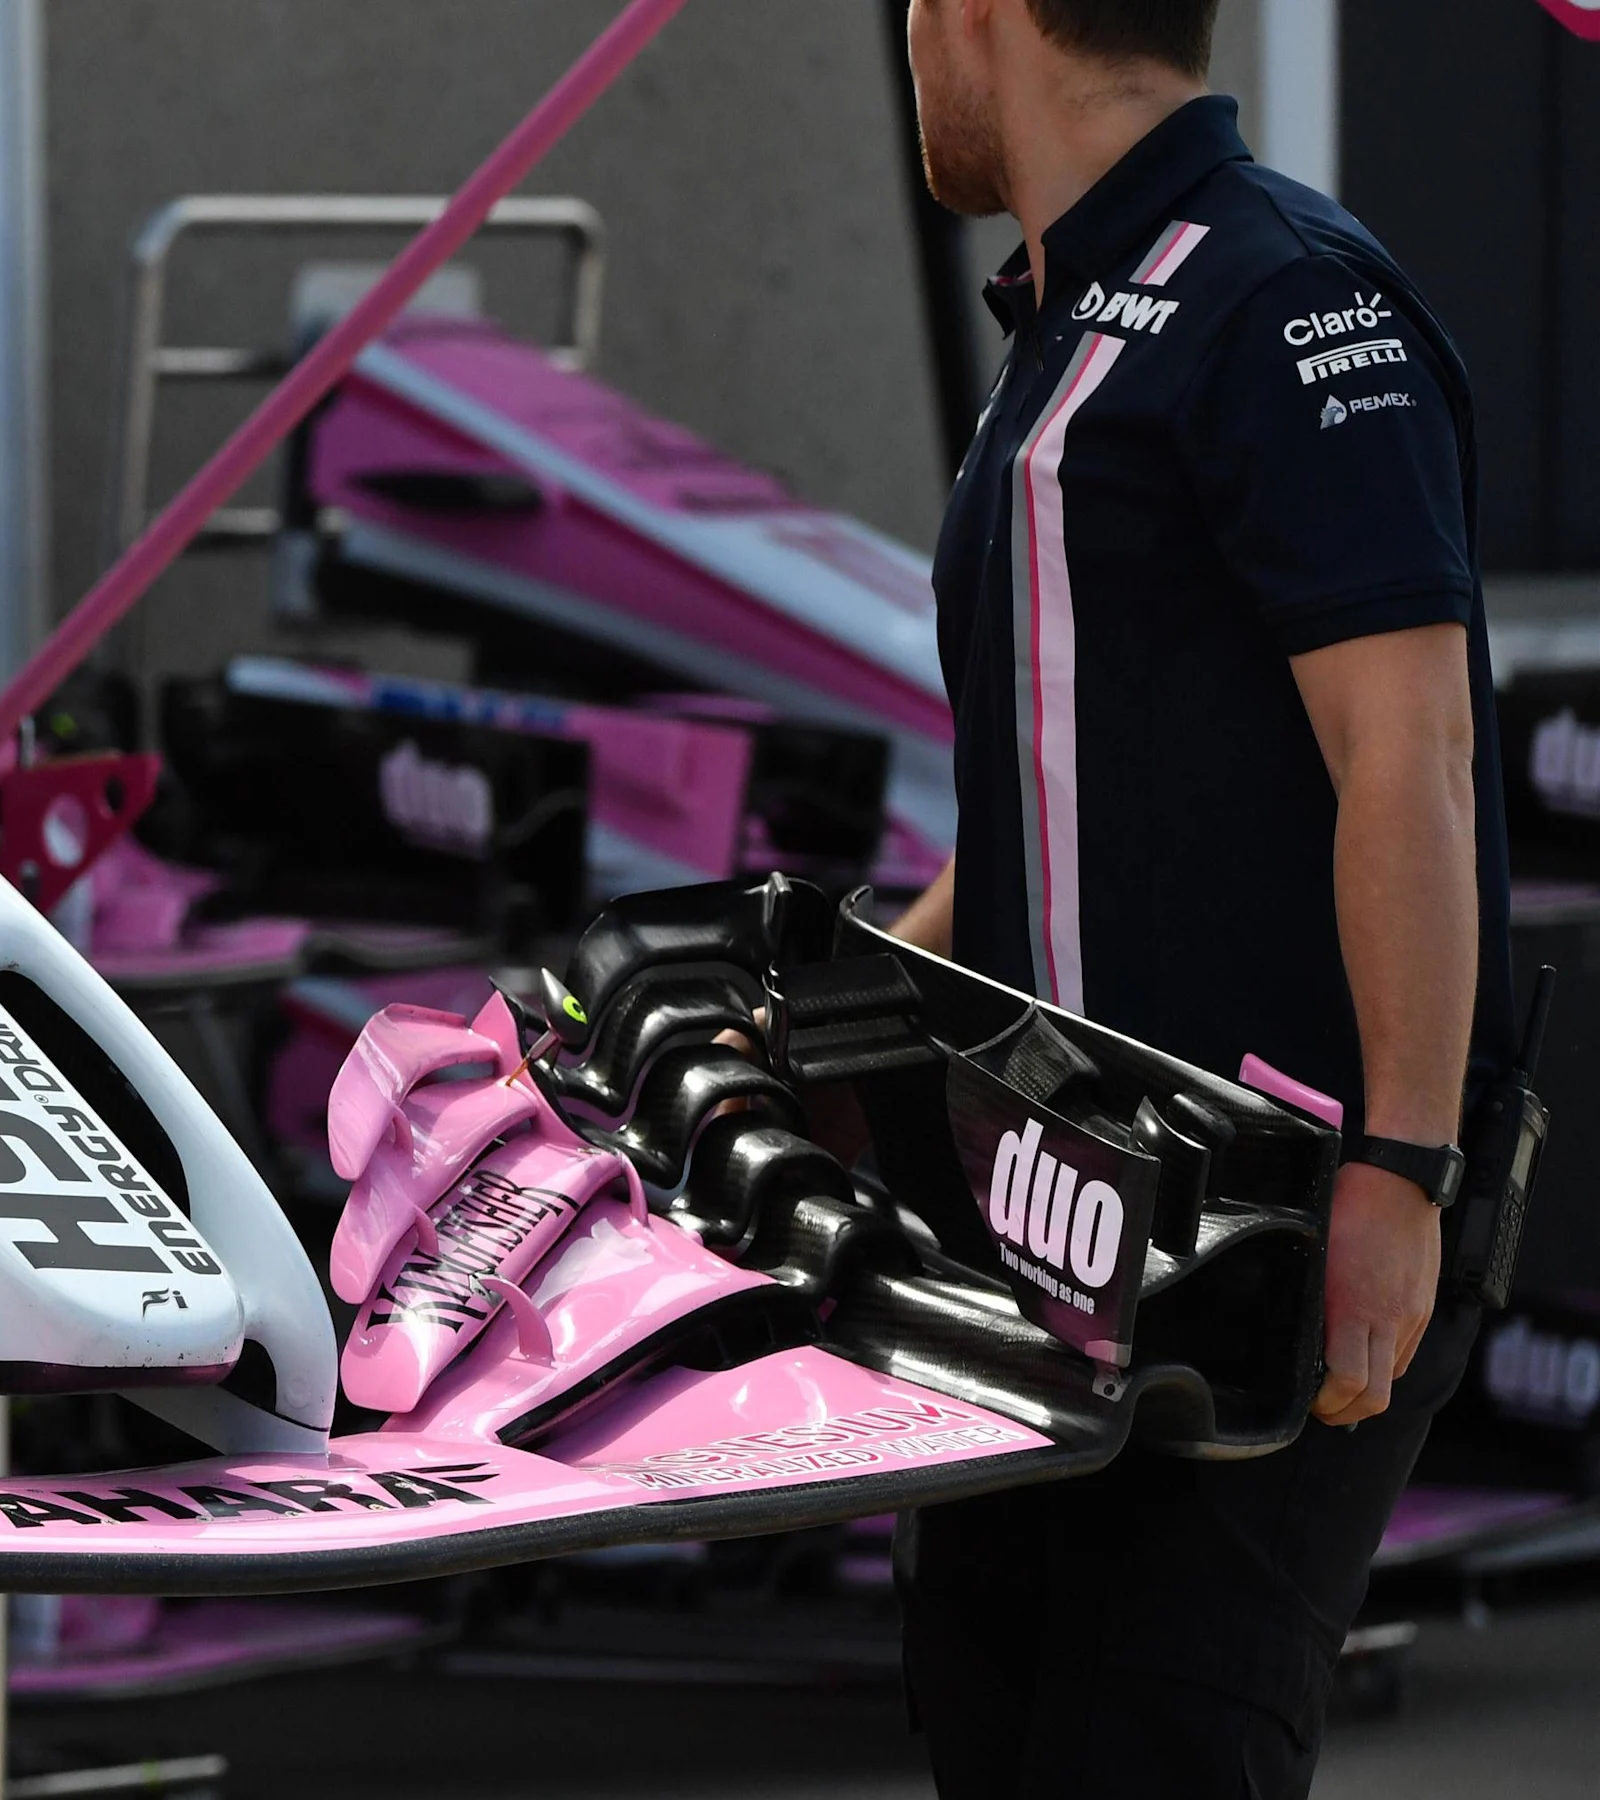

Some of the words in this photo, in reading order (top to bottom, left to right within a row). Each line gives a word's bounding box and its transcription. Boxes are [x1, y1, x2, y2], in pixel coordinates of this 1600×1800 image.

[1096, 291, 1180, 335] BWT
[1284, 300, 1384, 346] Claro
[1296, 339, 1408, 385] PIRELLI
[1349, 393, 1411, 414] PEMEX
[989, 1117, 1124, 1288] duo
[1000, 1242, 1019, 1272] Two
[1020, 1257, 1059, 1299] working
[1059, 1282, 1072, 1304] as
[1073, 1289, 1095, 1315] one
